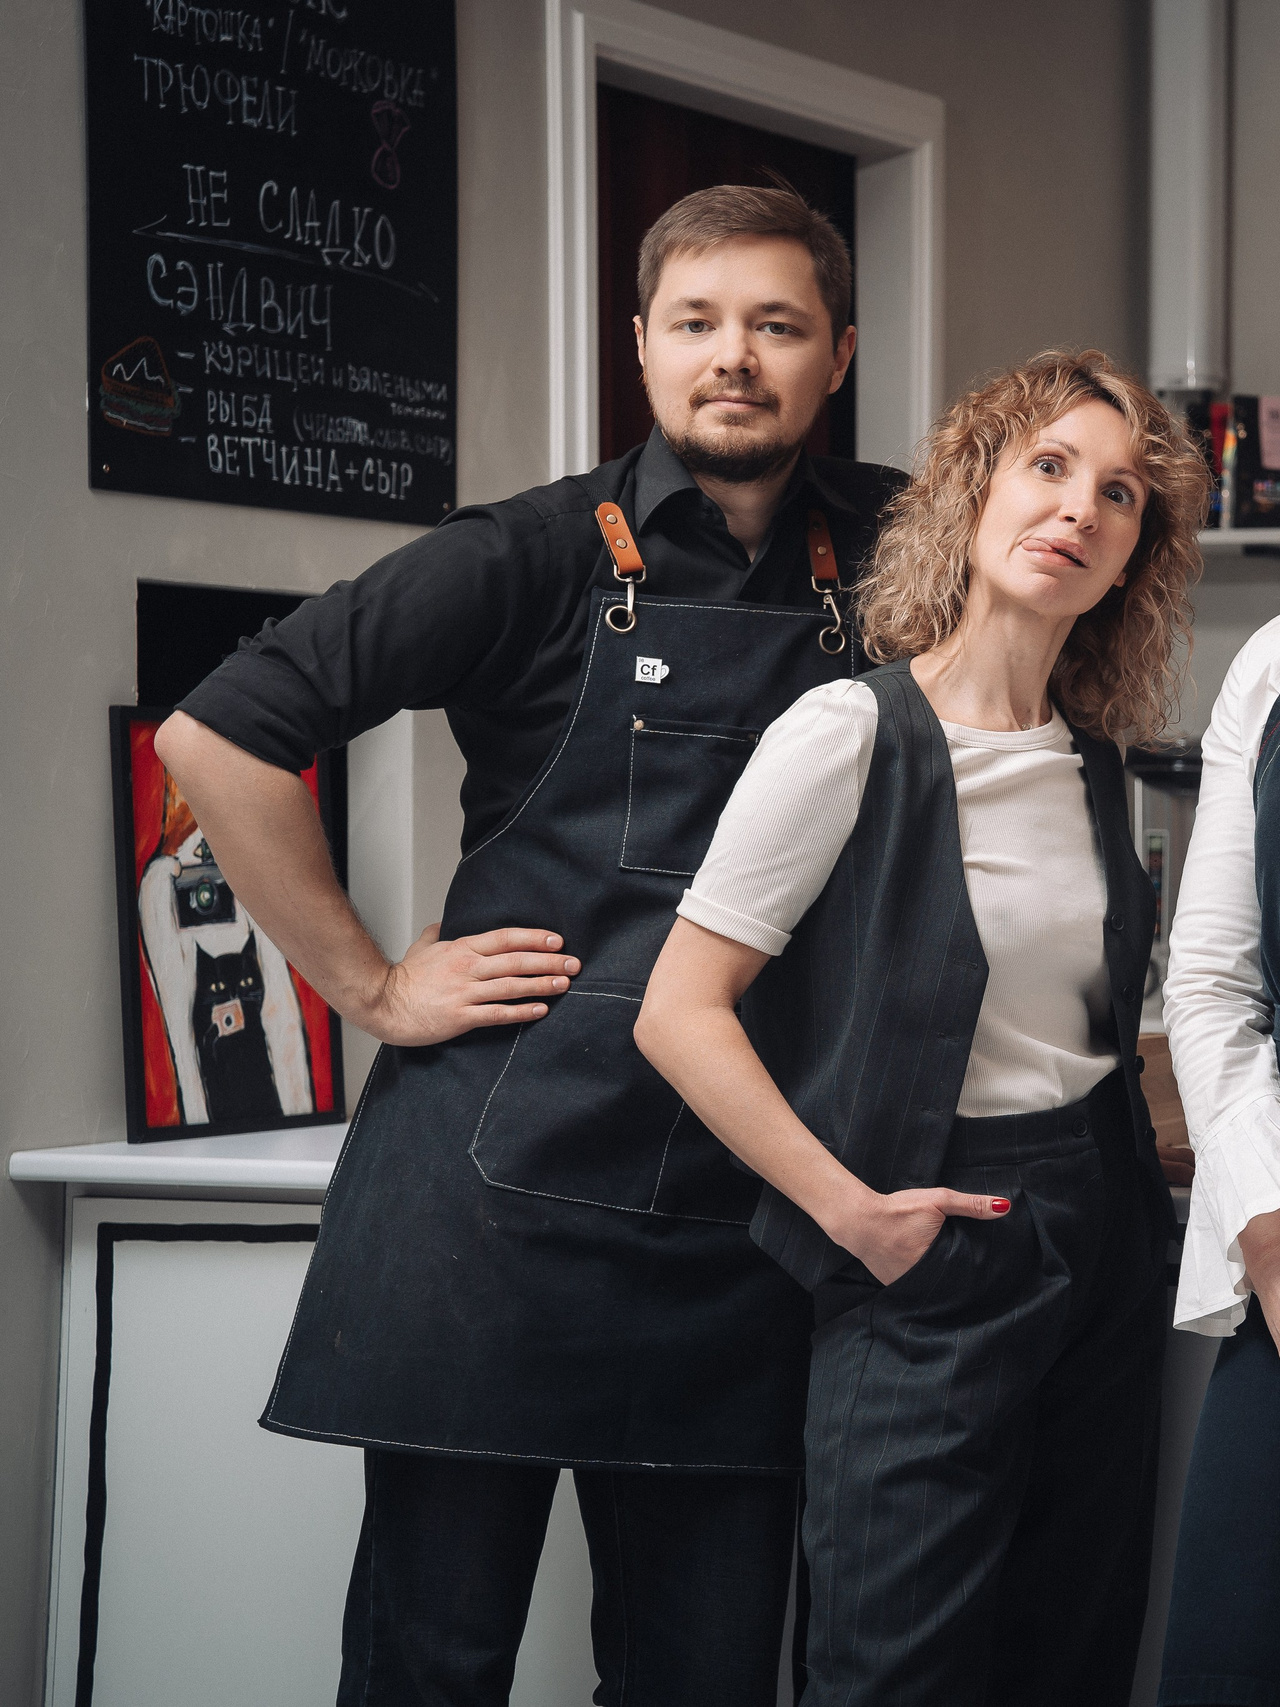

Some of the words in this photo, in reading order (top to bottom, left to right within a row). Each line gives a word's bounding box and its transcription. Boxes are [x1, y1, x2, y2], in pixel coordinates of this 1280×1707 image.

[134, 53, 297, 136] ТРЮФЕЛИ
[182, 163, 231, 227] НЕ
[259, 180, 396, 270] СЛАДКО
[146, 252, 334, 351] СЭНДВИЧ
[206, 389, 275, 434] РЫБА
[640, 664, 657, 676] Cf
